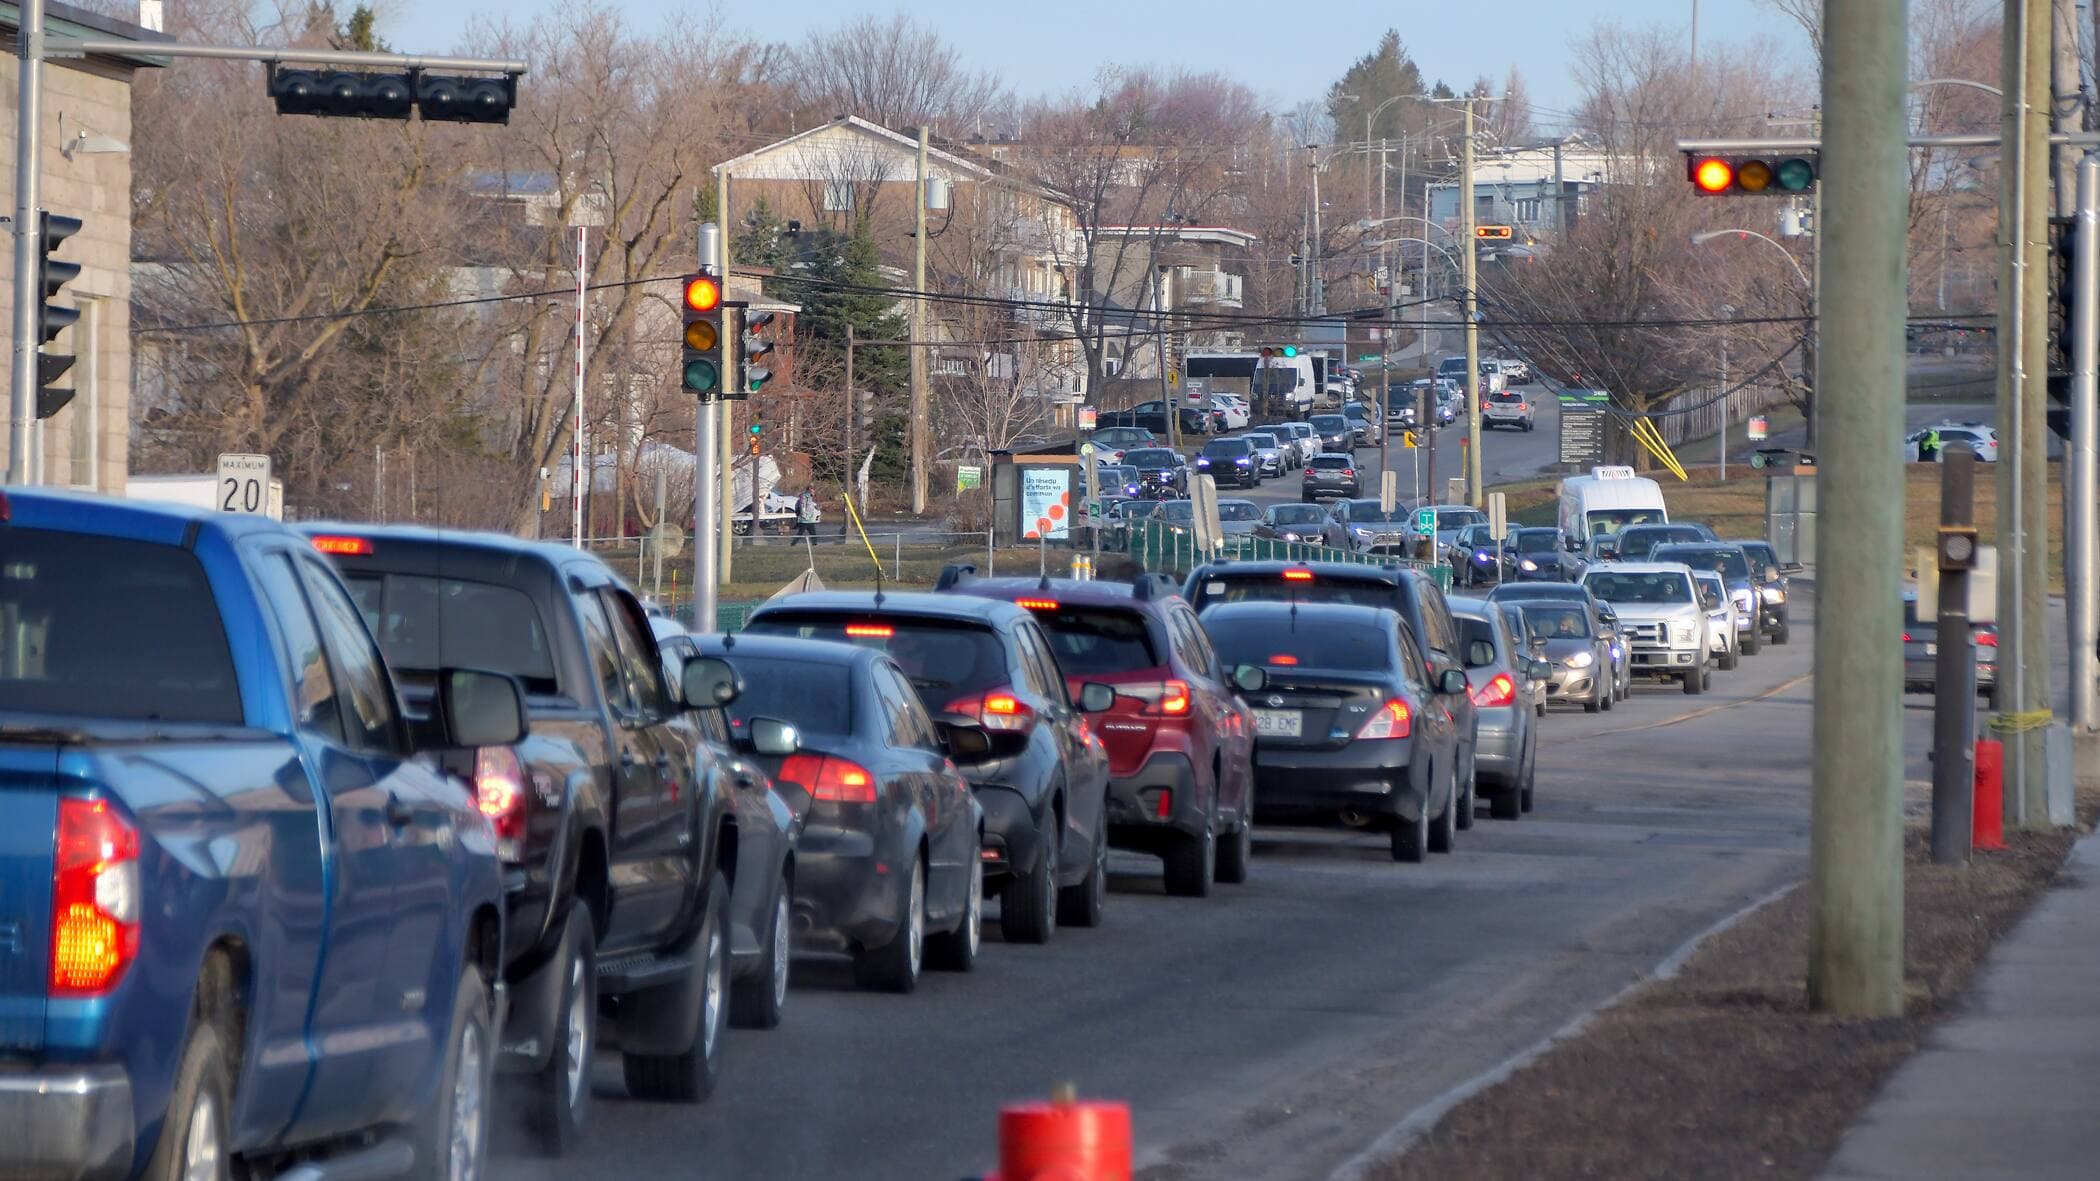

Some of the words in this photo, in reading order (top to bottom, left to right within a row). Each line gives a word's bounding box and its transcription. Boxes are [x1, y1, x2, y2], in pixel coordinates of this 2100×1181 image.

[222, 461, 265, 469] MAXIMUM
[223, 477, 260, 512] 20
[1255, 716, 1271, 730] 28
